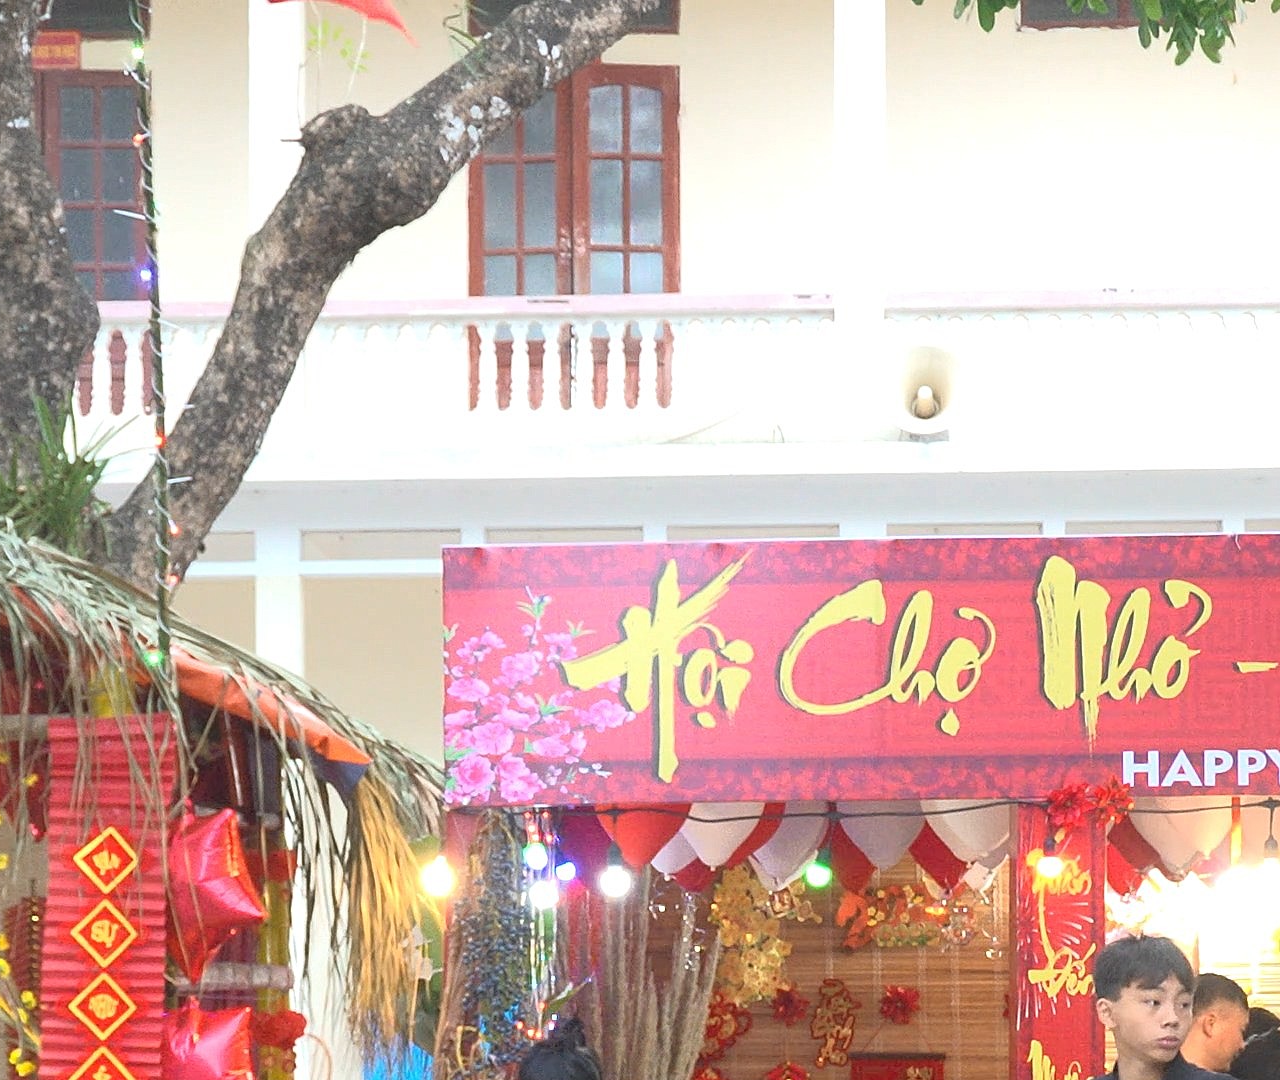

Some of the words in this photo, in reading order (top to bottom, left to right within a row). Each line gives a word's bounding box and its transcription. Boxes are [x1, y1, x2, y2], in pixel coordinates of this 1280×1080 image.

[560, 549, 755, 784] Hội
[780, 579, 996, 736] Chợ
[1037, 555, 1213, 755] Nhỏ
